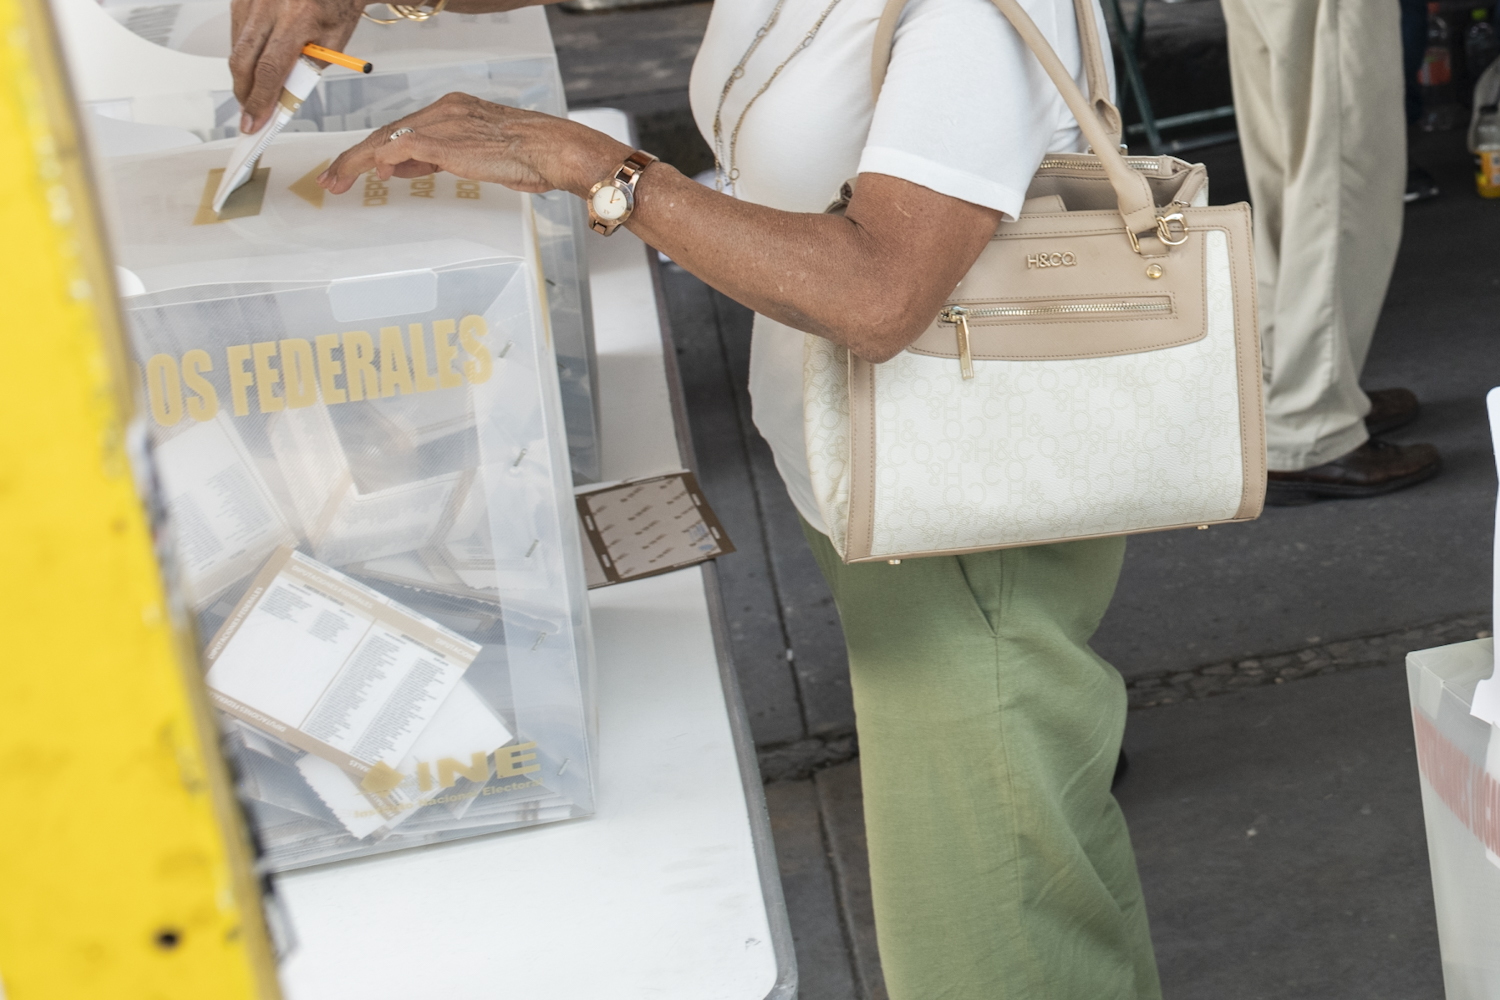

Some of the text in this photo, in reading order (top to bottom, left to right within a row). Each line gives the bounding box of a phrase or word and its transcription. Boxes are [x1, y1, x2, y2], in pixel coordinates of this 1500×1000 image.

[136, 313, 494, 428] OS FEDERALES
[416, 741, 541, 792] INE
